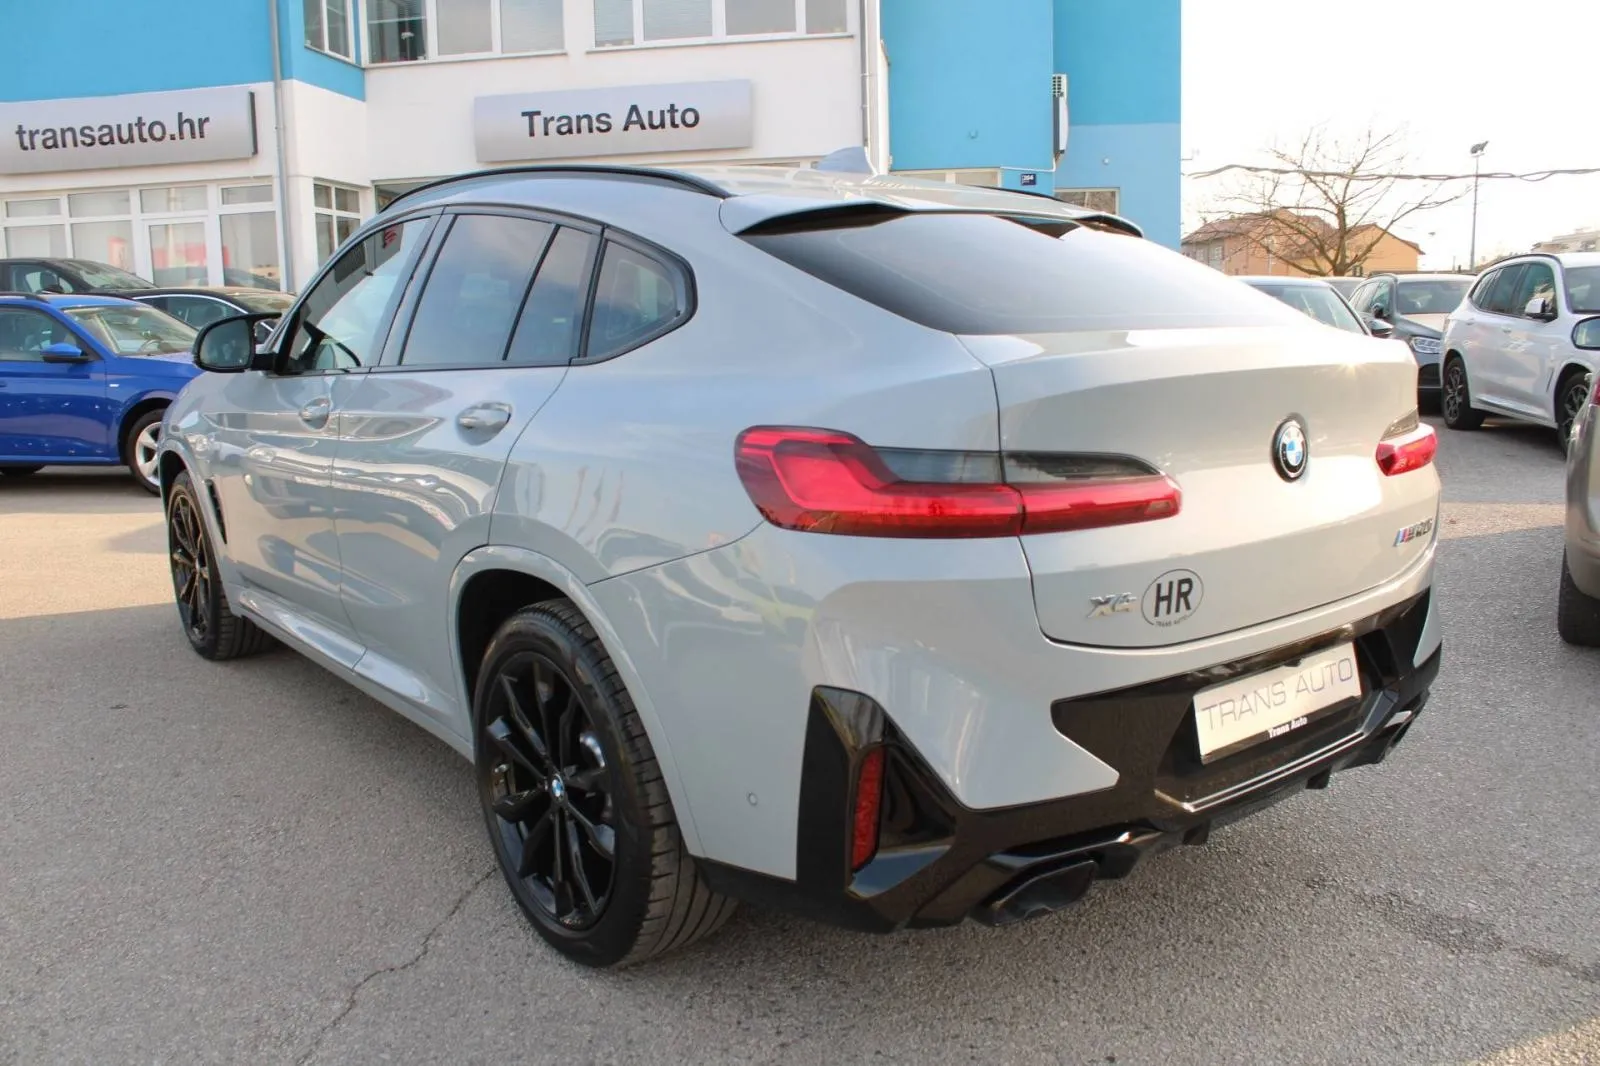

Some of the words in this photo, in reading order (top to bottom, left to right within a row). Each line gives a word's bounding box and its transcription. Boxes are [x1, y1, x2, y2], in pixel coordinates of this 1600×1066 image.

[15, 112, 210, 151] transauto.hr
[521, 110, 613, 137] Trans
[622, 103, 700, 132] Auto
[1154, 577, 1193, 618] HR
[1200, 680, 1287, 730] TRANS
[1295, 657, 1353, 695] AUTO
[1268, 723, 1290, 739] Trans
[1290, 716, 1308, 730] Auto
